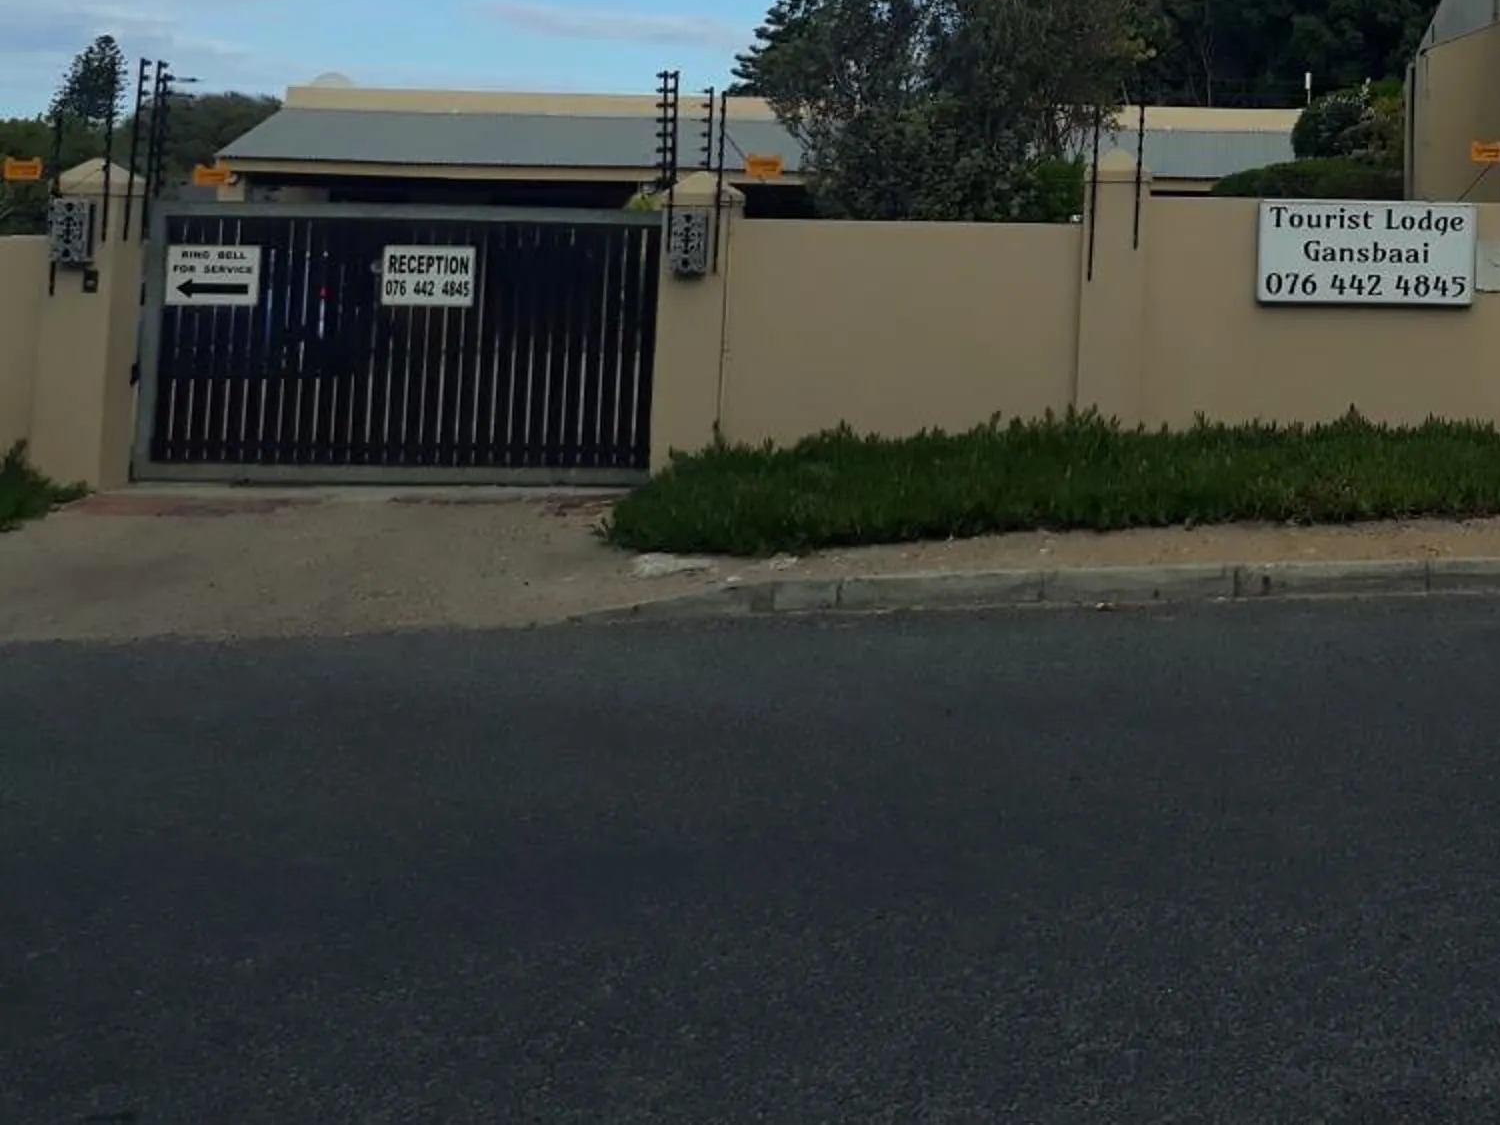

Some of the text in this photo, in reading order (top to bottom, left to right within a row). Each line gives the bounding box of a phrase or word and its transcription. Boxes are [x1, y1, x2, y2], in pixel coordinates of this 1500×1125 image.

[1269, 206, 1465, 236] Tourist Lodge
[181, 250, 247, 260] RING BELL
[1303, 240, 1430, 264] Gansbaai
[172, 264, 252, 274] FOR SERVICE
[388, 254, 470, 275] RECEPTION
[385, 280, 471, 297] 076 442 4845
[1265, 272, 1467, 298] 076 442 4845
